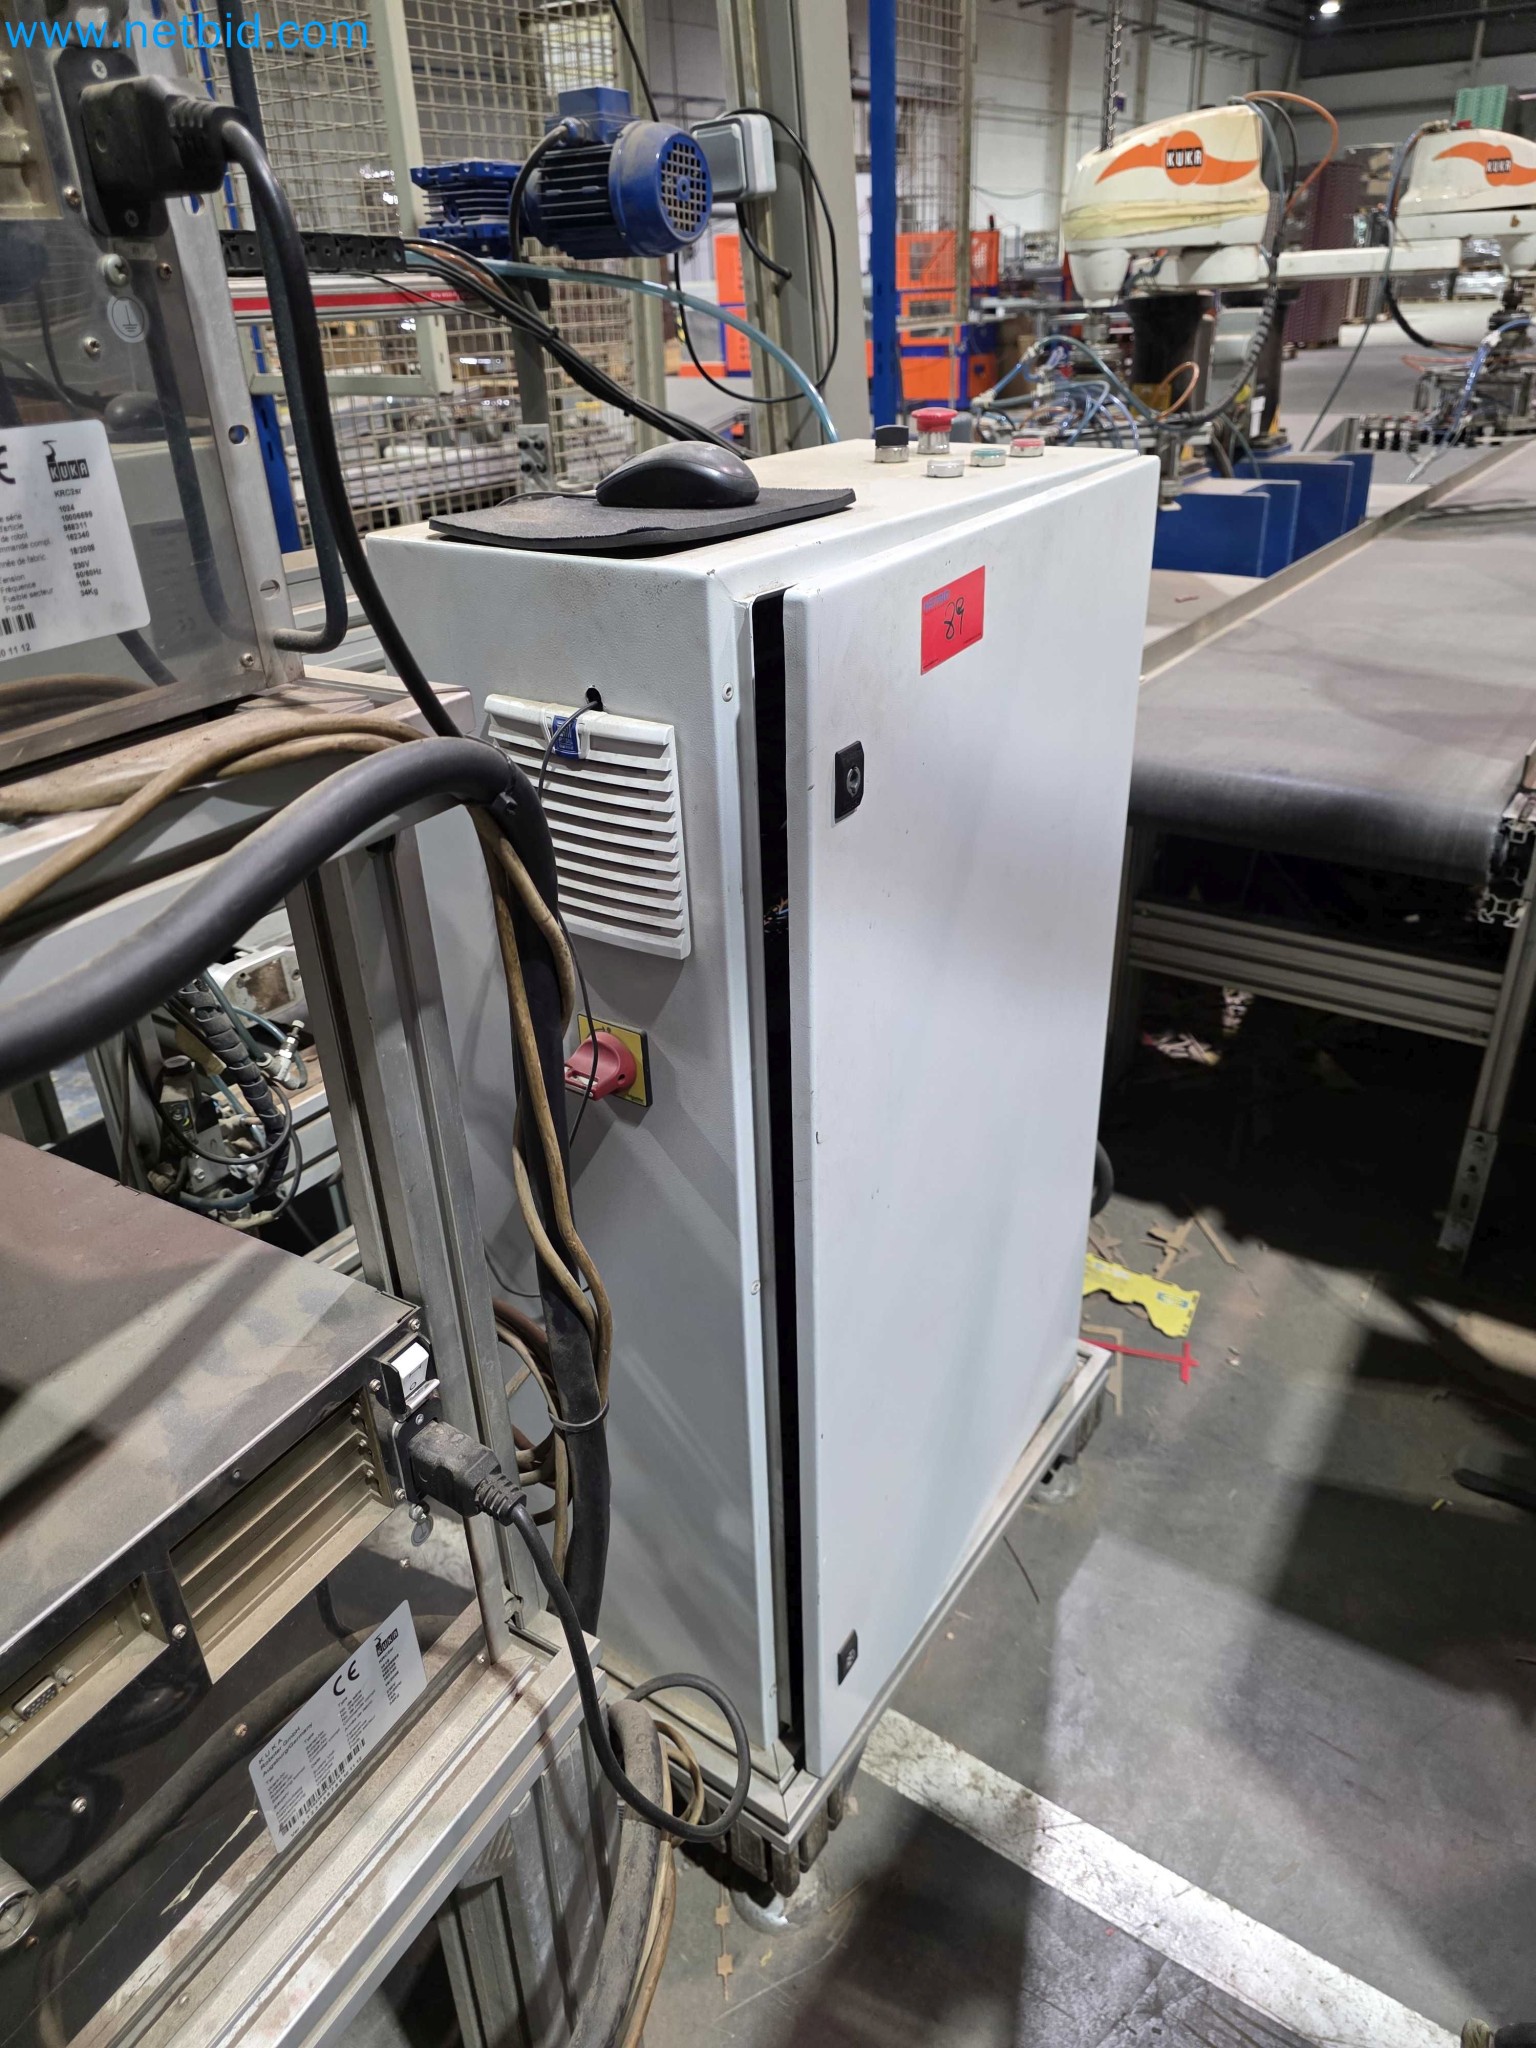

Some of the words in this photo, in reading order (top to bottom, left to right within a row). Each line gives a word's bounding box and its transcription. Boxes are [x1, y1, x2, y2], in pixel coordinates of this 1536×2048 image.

[1166, 148, 1203, 169] KUKA
[48, 458, 90, 482] KUKA
[59, 504, 75, 512] 1024
